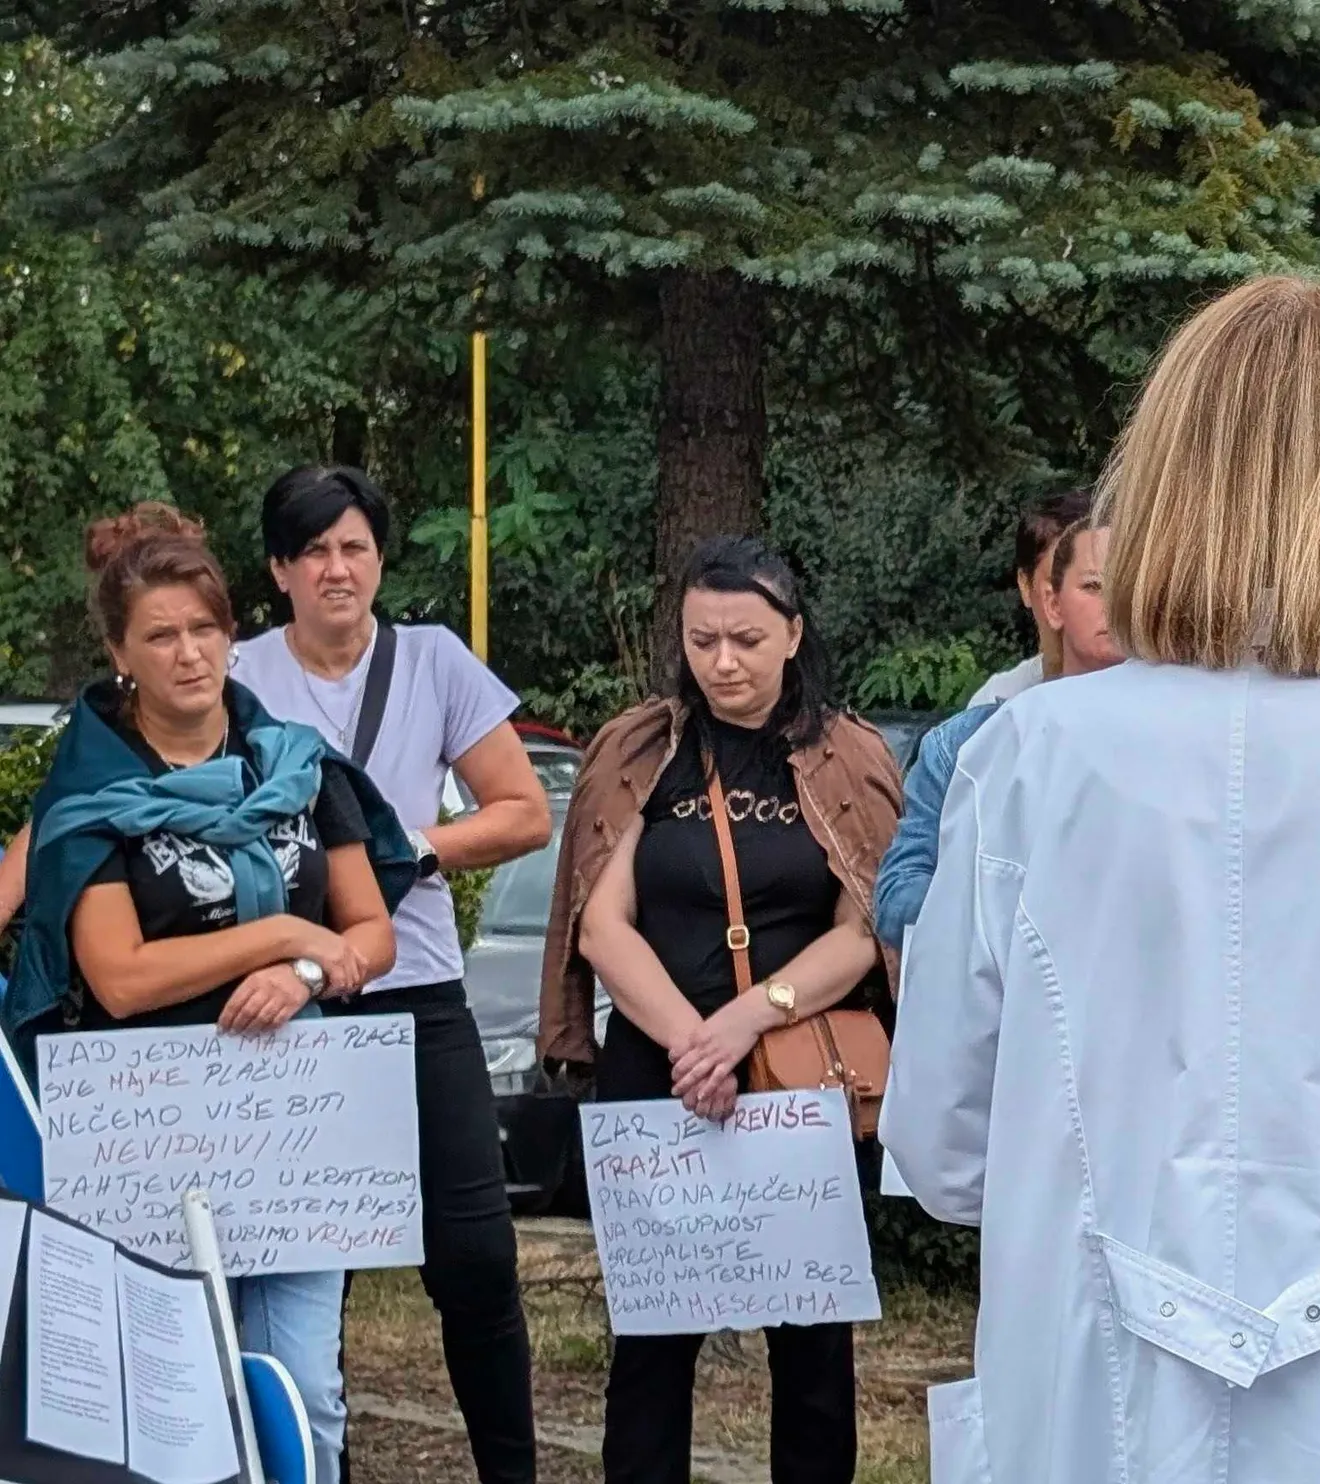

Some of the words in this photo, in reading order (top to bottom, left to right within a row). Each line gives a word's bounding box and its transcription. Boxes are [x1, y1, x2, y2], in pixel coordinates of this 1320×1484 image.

[47, 1040, 117, 1073] KAD
[126, 1037, 222, 1069] JEDNA
[238, 1030, 336, 1058] MAJKA
[343, 1021, 413, 1050] PLAČE
[44, 1079, 96, 1103] SVE
[110, 1066, 190, 1097] MAJKE
[206, 1091, 275, 1121] VIŠE
[287, 1091, 345, 1117] BITI
[591, 1113, 659, 1148] ZAR
[667, 1115, 706, 1146] JE
[593, 1145, 706, 1183] TRAŽITI
[47, 1167, 255, 1206] ZAHTJEVAMO
[279, 1169, 294, 1186] U
[302, 1165, 416, 1191] KRATKOM
[597, 1182, 675, 1217] PRAVO
[682, 1183, 714, 1204] NA
[720, 1173, 843, 1213] LIJEČENJE
[64, 1207, 132, 1226] OKU
[250, 1196, 349, 1216] SISTEM
[355, 1192, 417, 1220] RIJEŠI
[217, 1224, 299, 1244] UBIMO
[307, 1221, 408, 1254] VRIJEME
[603, 1221, 627, 1247] NA
[632, 1213, 775, 1237] DOSTUPNOST
[607, 1238, 764, 1270] SPECIJALISTE
[606, 1267, 665, 1290] PRAVO
[674, 1266, 700, 1283] NA
[705, 1258, 791, 1284] TERMIN
[804, 1259, 862, 1286] BEZ
[688, 1291, 838, 1324] MJESECIMA
